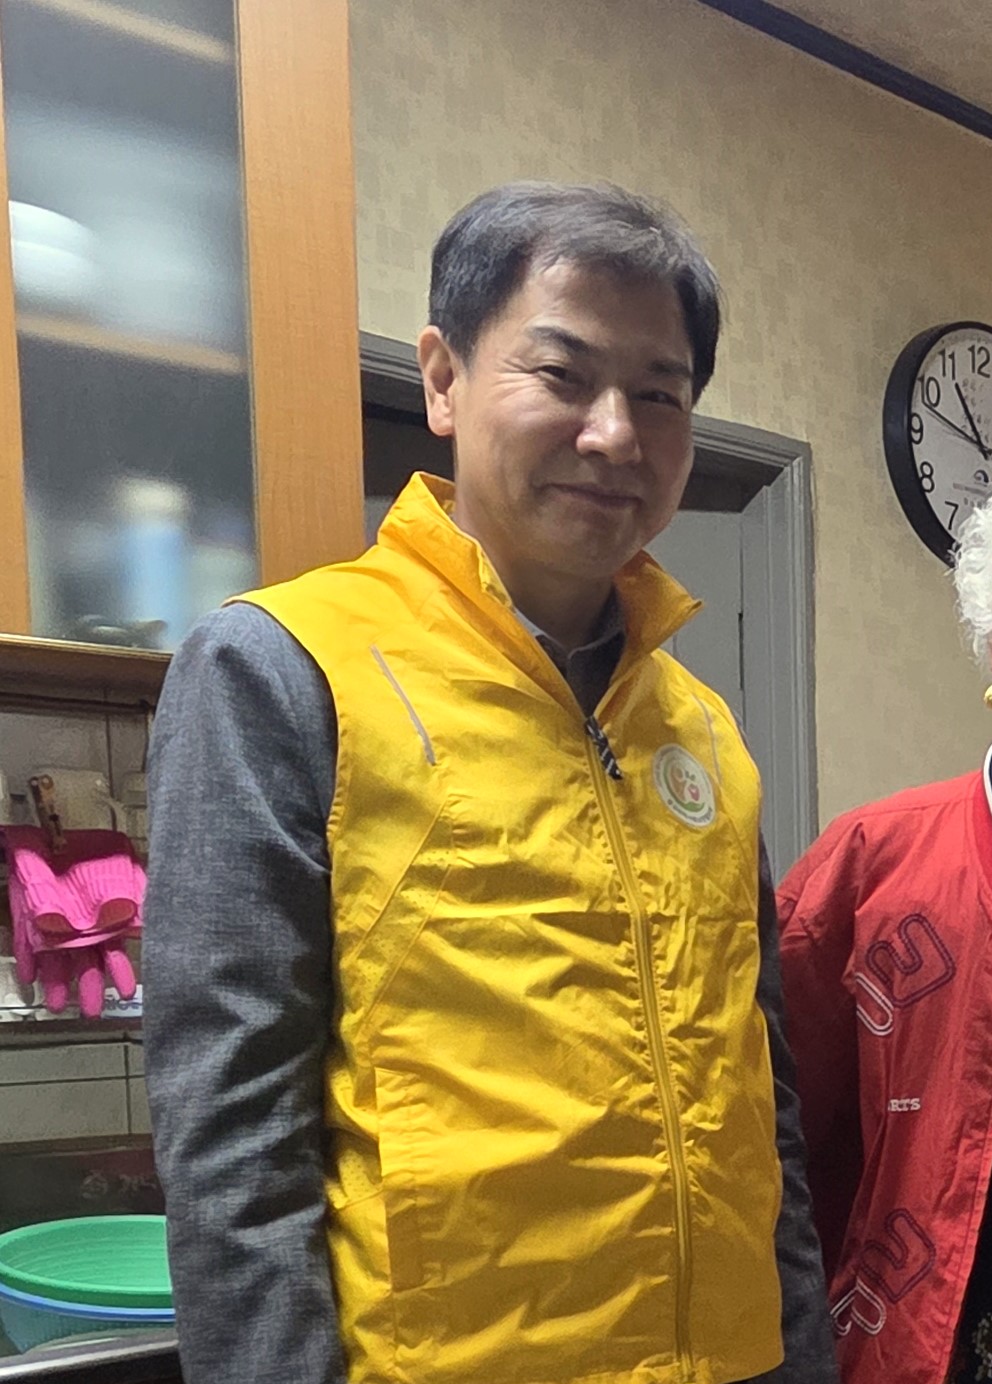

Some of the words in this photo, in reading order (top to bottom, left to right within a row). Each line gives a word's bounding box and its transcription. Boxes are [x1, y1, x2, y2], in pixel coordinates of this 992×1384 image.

[938, 348, 956, 381] 11
[967, 345, 990, 378] 12
[917, 374, 941, 408] 10
[910, 413, 924, 445] 9
[920, 461, 936, 493] 8
[944, 500, 959, 530] 7
[888, 1097, 921, 1112] RTS
